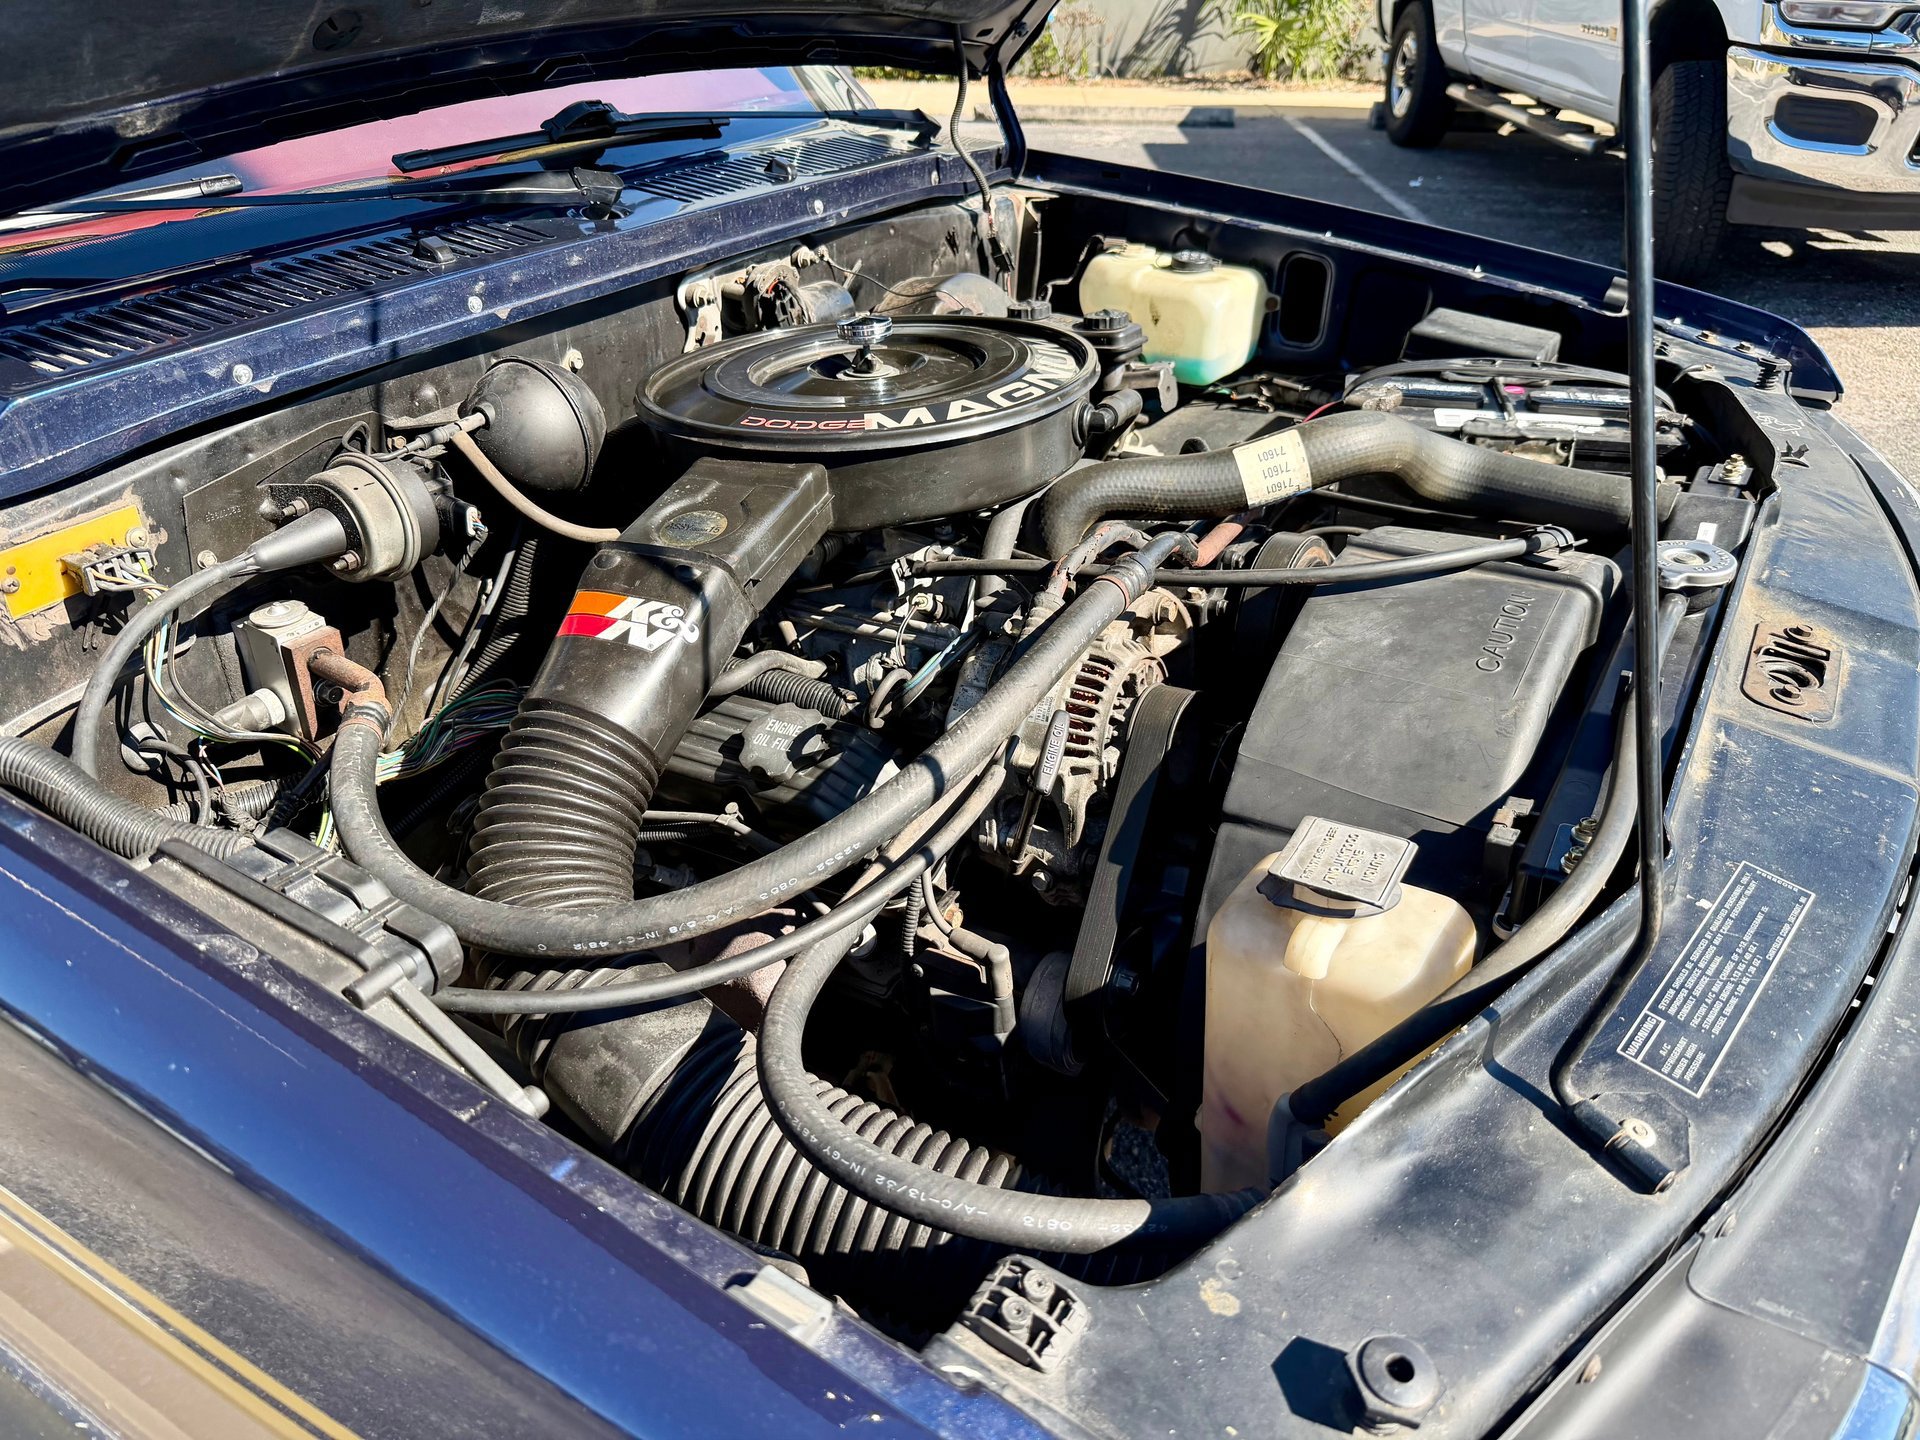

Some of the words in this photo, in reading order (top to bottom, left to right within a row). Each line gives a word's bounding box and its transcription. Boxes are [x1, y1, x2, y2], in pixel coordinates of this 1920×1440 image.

[740, 417, 872, 430] DODGE
[864, 338, 1078, 429] MAGNUM
[1257, 446, 1286, 462] 71601
[1262, 462, 1291, 479] 71601
[1266, 478, 1294, 494] 71601
[595, 597, 700, 651] K&N
[1475, 592, 1535, 672] CAUTION
[753, 733, 768, 746] OIL
[771, 737, 794, 752] FILL
[765, 719, 803, 737] ENGINE
[1042, 739, 1060, 775] ENGINE
[1052, 723, 1065, 738] OIL
[1361, 852, 1385, 883] CAUTION
[1767, 937, 1784, 960] CHRYSLER
[1799, 896, 1807, 904] MI
[1659, 989, 1676, 1010] SYSTEM
[1673, 969, 1689, 989] SHOULD
[1685, 961, 1694, 970] BE
[1691, 939, 1708, 962] SERVICED
[1705, 931, 1713, 939] BY
[1710, 909, 1728, 931] QUALIFIED
[1725, 885, 1744, 909] PERSONNEL
[1668, 989, 1688, 1015] IMPROPER
[1685, 968, 1702, 989] SERVICE
[1699, 946, 1716, 968] METHODS
[1713, 934, 1724, 945] MAY
[1720, 919, 1734, 934] CAUSE
[1691, 1004, 1708, 1028] FACTORY
[1706, 992, 1716, 1004] A/C
[1712, 980, 1723, 993] MAX
[1720, 961, 1735, 980] CHARGE
[1732, 953, 1739, 961] OF
[1736, 941, 1748, 954] R-12
[1744, 913, 1764, 941] REFRIGERANT
[1678, 997, 1696, 1021] CONSULT
[1693, 976, 1710, 997] SERVICE
[1703, 1001, 1723, 1029] STANDARD
[1720, 982, 1734, 1001] ENGINE
[1738, 963, 1746, 971] KG
[1749, 945, 1757, 953] OZ
[1712, 1017, 1727, 1035] DIESEL
[1724, 997, 1739, 1016] ENGINE
[1742, 977, 1751, 985] KG
[1753, 958, 1761, 967] OZ
[1627, 1018, 1656, 1055] WARNING
[1660, 1043, 1671, 1056] A/C
[1662, 1037, 1688, 1073] REFRIGERANT
[1673, 1058, 1688, 1078] UNDER
[1685, 1043, 1698, 1059] HIGH
[1685, 1052, 1706, 1081] PRESSURE
[823, 1146, 866, 1176] IN-GY
[1023, 1216, 1072, 1231] 0813
